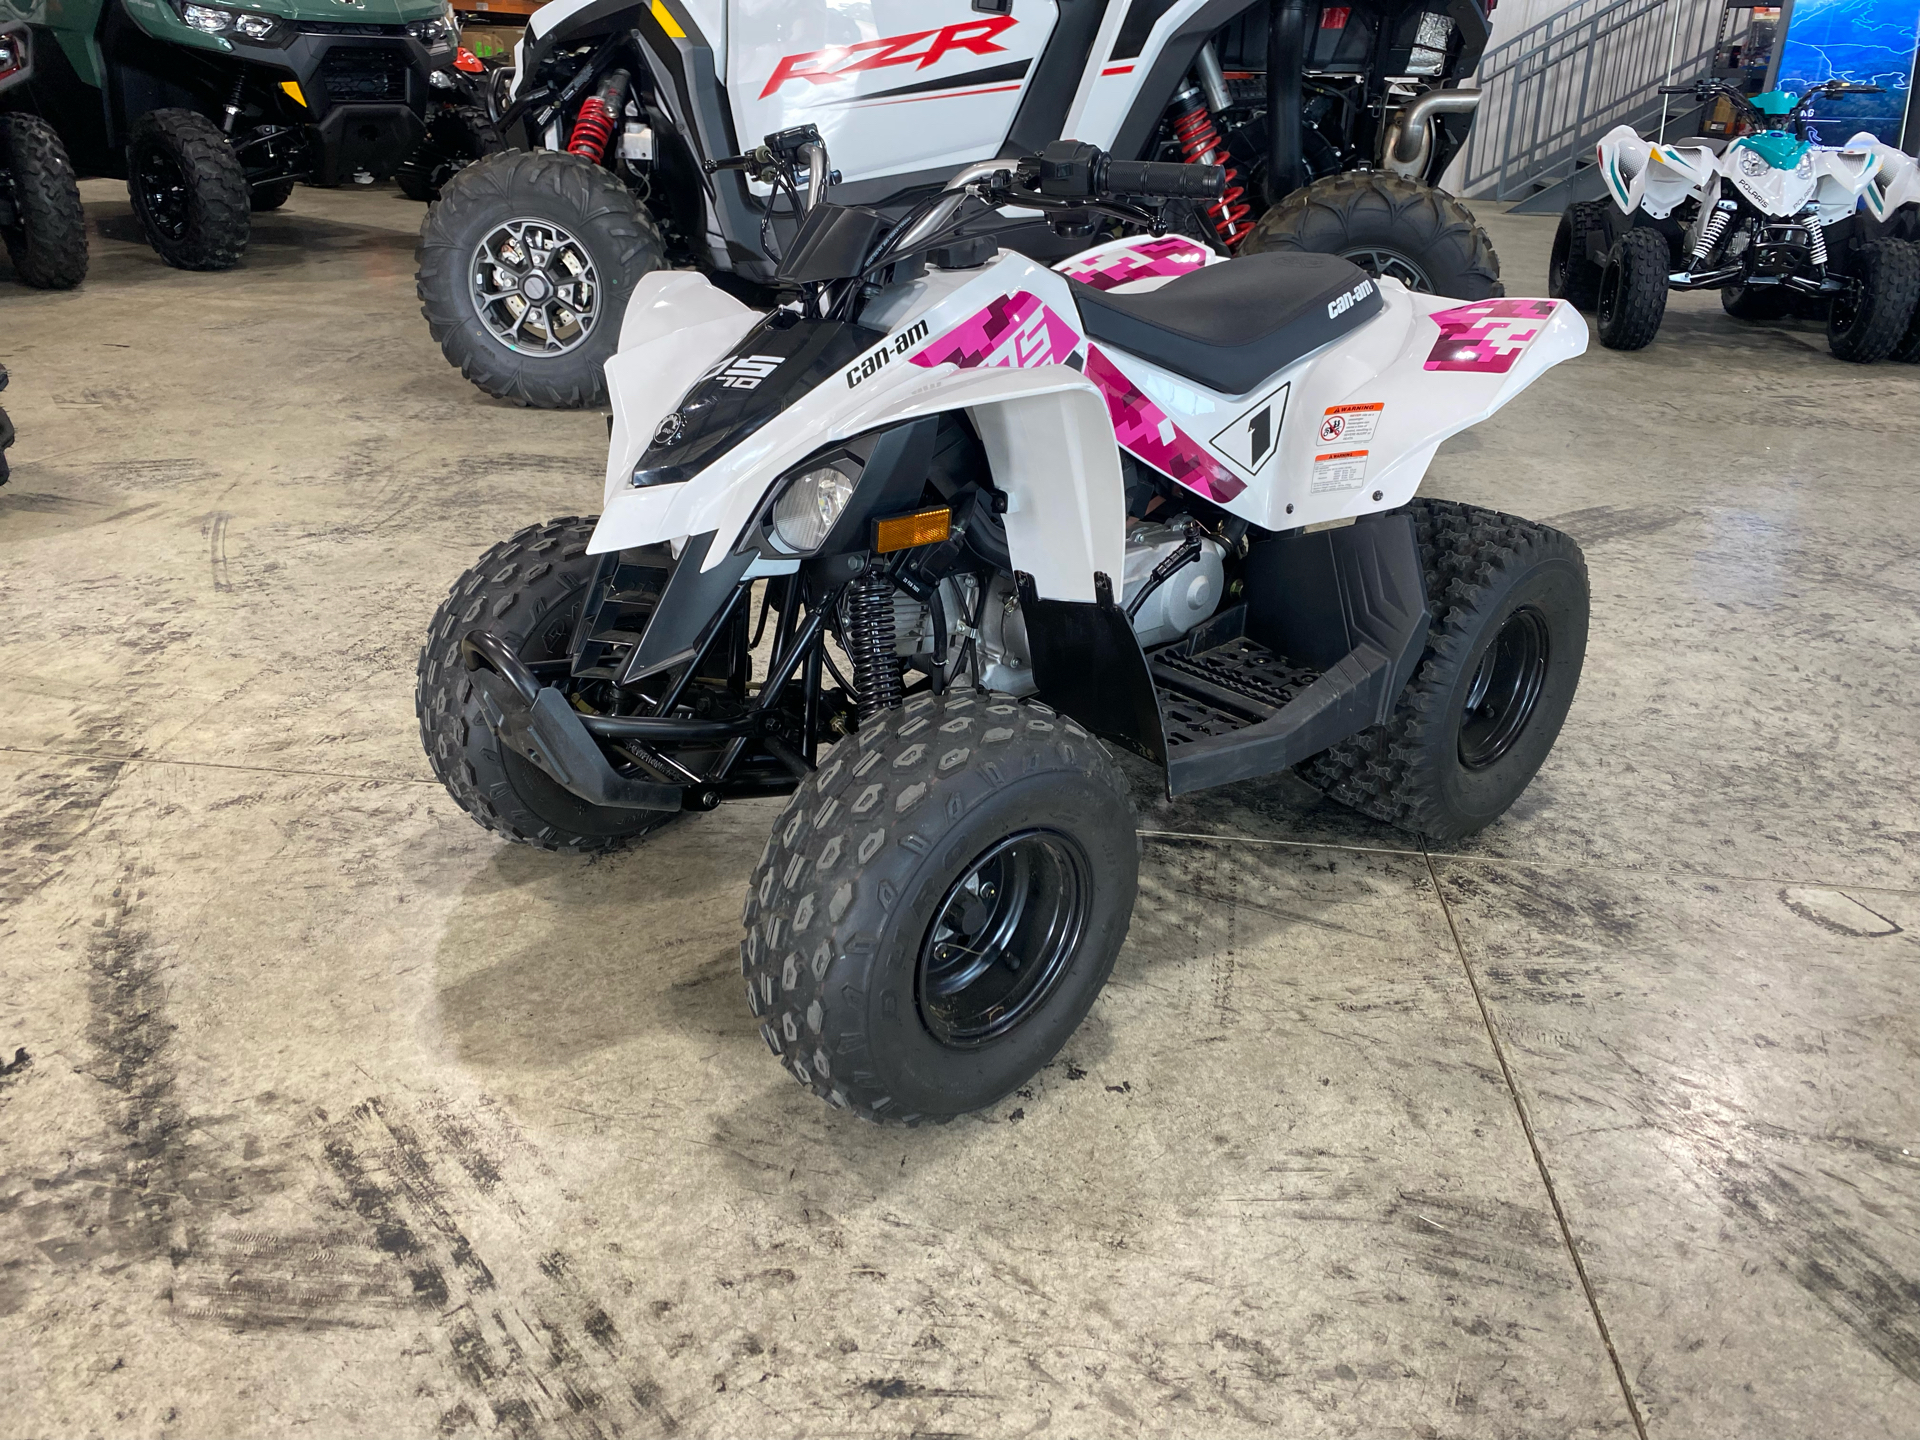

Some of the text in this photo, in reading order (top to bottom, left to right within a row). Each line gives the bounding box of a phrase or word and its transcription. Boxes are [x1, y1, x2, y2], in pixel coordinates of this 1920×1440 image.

[757, 15, 1020, 101] RZR
[1738, 178, 1770, 209] POLARIS
[1327, 279, 1374, 320] can-am
[846, 318, 930, 390] can-am
[715, 376, 762, 390] 70
[1340, 404, 1375, 413] WARNING
